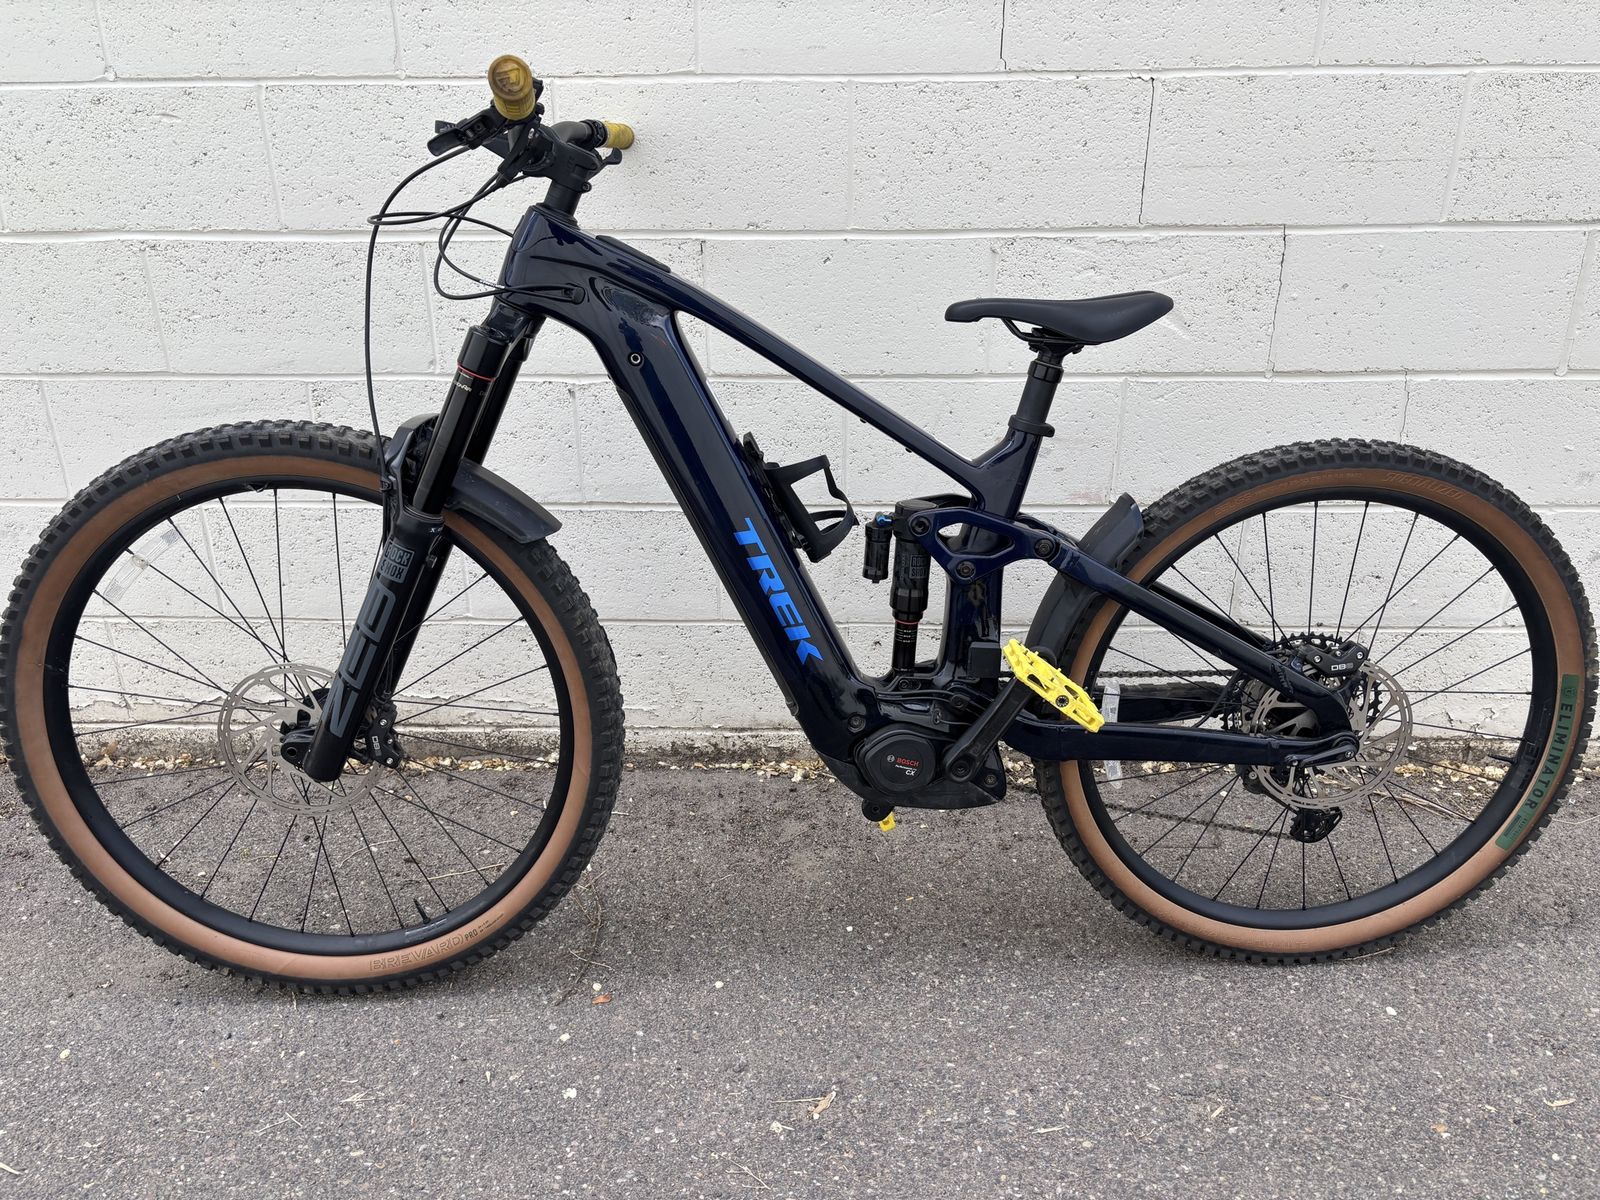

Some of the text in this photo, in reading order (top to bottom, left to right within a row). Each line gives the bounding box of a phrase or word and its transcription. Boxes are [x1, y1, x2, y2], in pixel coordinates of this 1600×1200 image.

[380, 559, 405, 580] SHOX
[385, 542, 411, 566] ROCK
[733, 517, 824, 665] TREK
[321, 577, 397, 739] ZEB
[896, 757, 920, 768] BOSCH
[905, 769, 917, 777] CX
[1524, 702, 1573, 811] ELIMINATOR
[369, 928, 479, 971] BREVARD PRO
